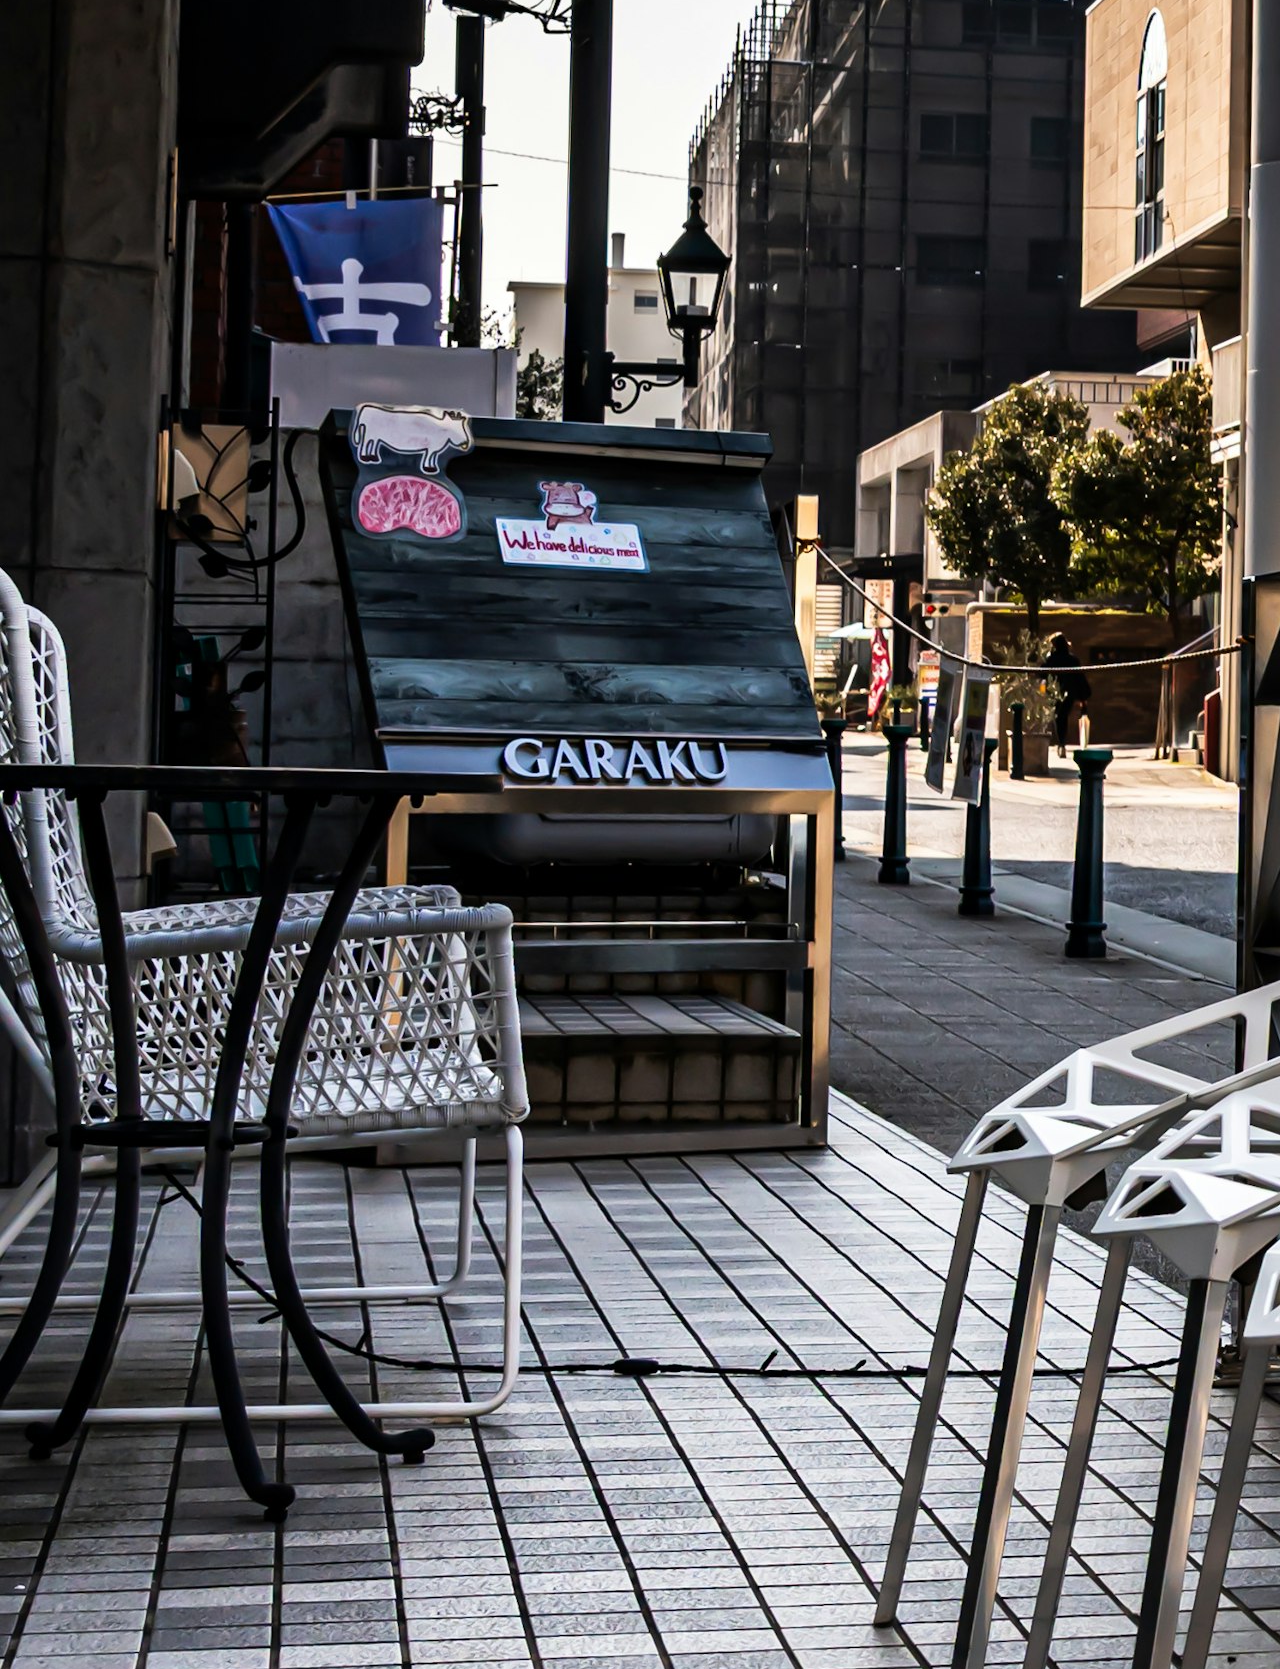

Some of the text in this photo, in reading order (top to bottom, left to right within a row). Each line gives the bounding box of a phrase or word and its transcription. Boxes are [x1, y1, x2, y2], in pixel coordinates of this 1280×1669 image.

[503, 530, 536, 550] We
[534, 530, 567, 553] have
[568, 536, 615, 557] delicious
[503, 737, 729, 782] GARAKU
